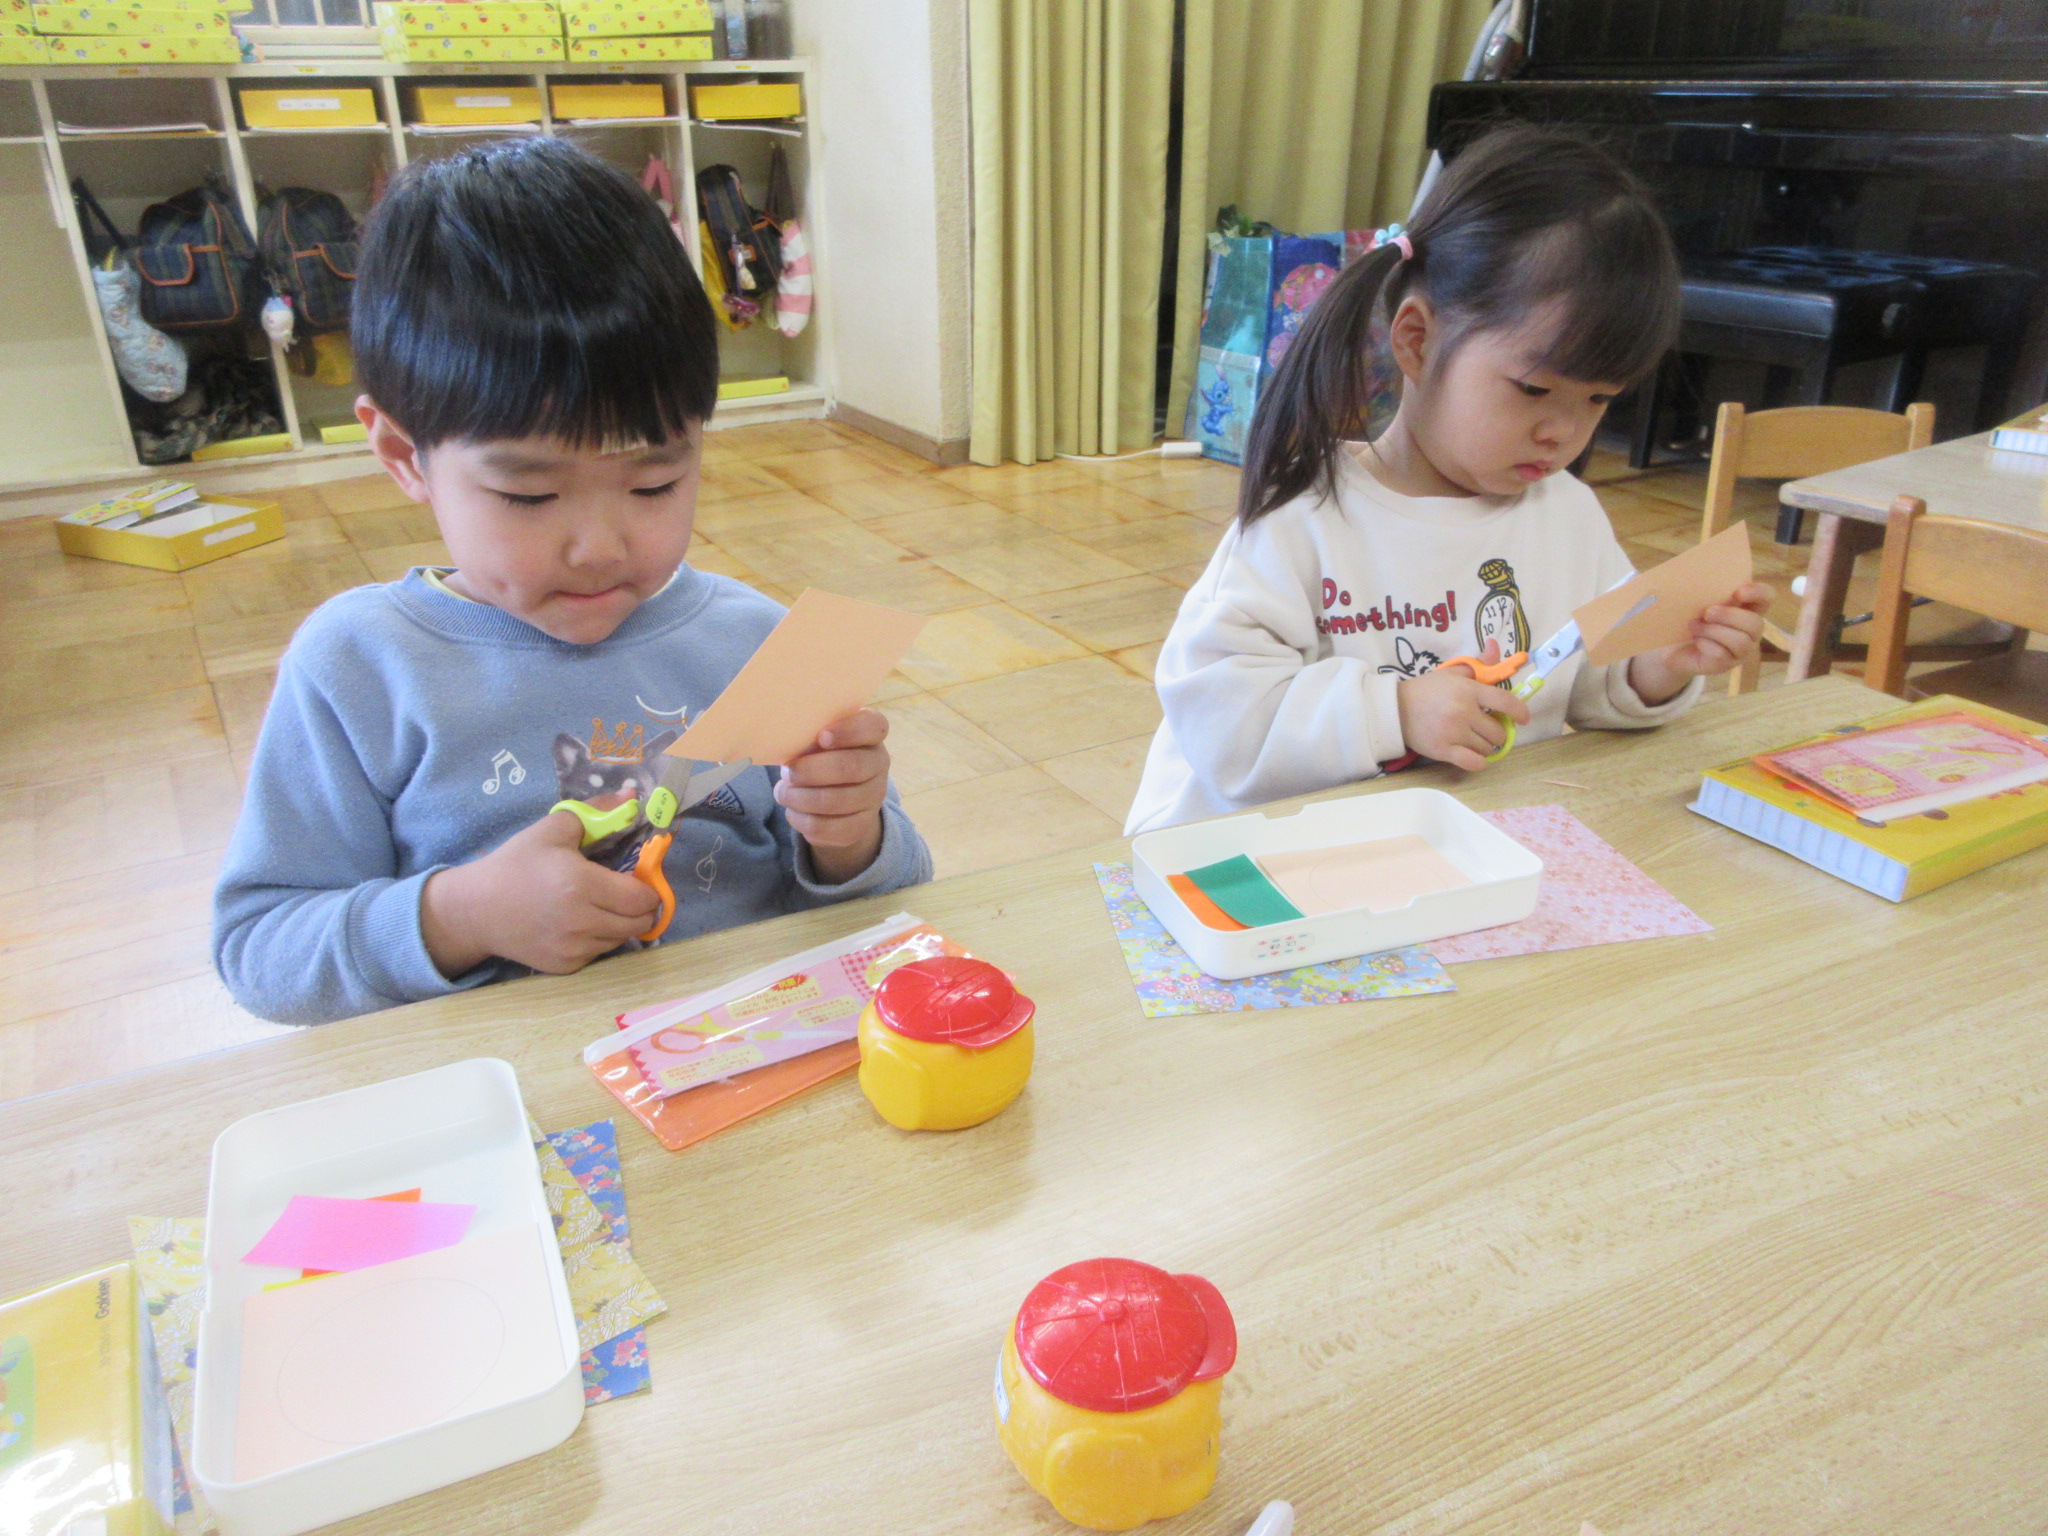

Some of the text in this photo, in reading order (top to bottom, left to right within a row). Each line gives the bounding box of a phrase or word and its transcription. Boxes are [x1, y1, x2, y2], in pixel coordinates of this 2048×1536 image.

[1322, 577, 1352, 609] Do
[1496, 597, 1507, 610] 12
[1485, 606, 1496, 618] 11
[1483, 623, 1494, 636] 10
[1508, 632, 1514, 643] 3
